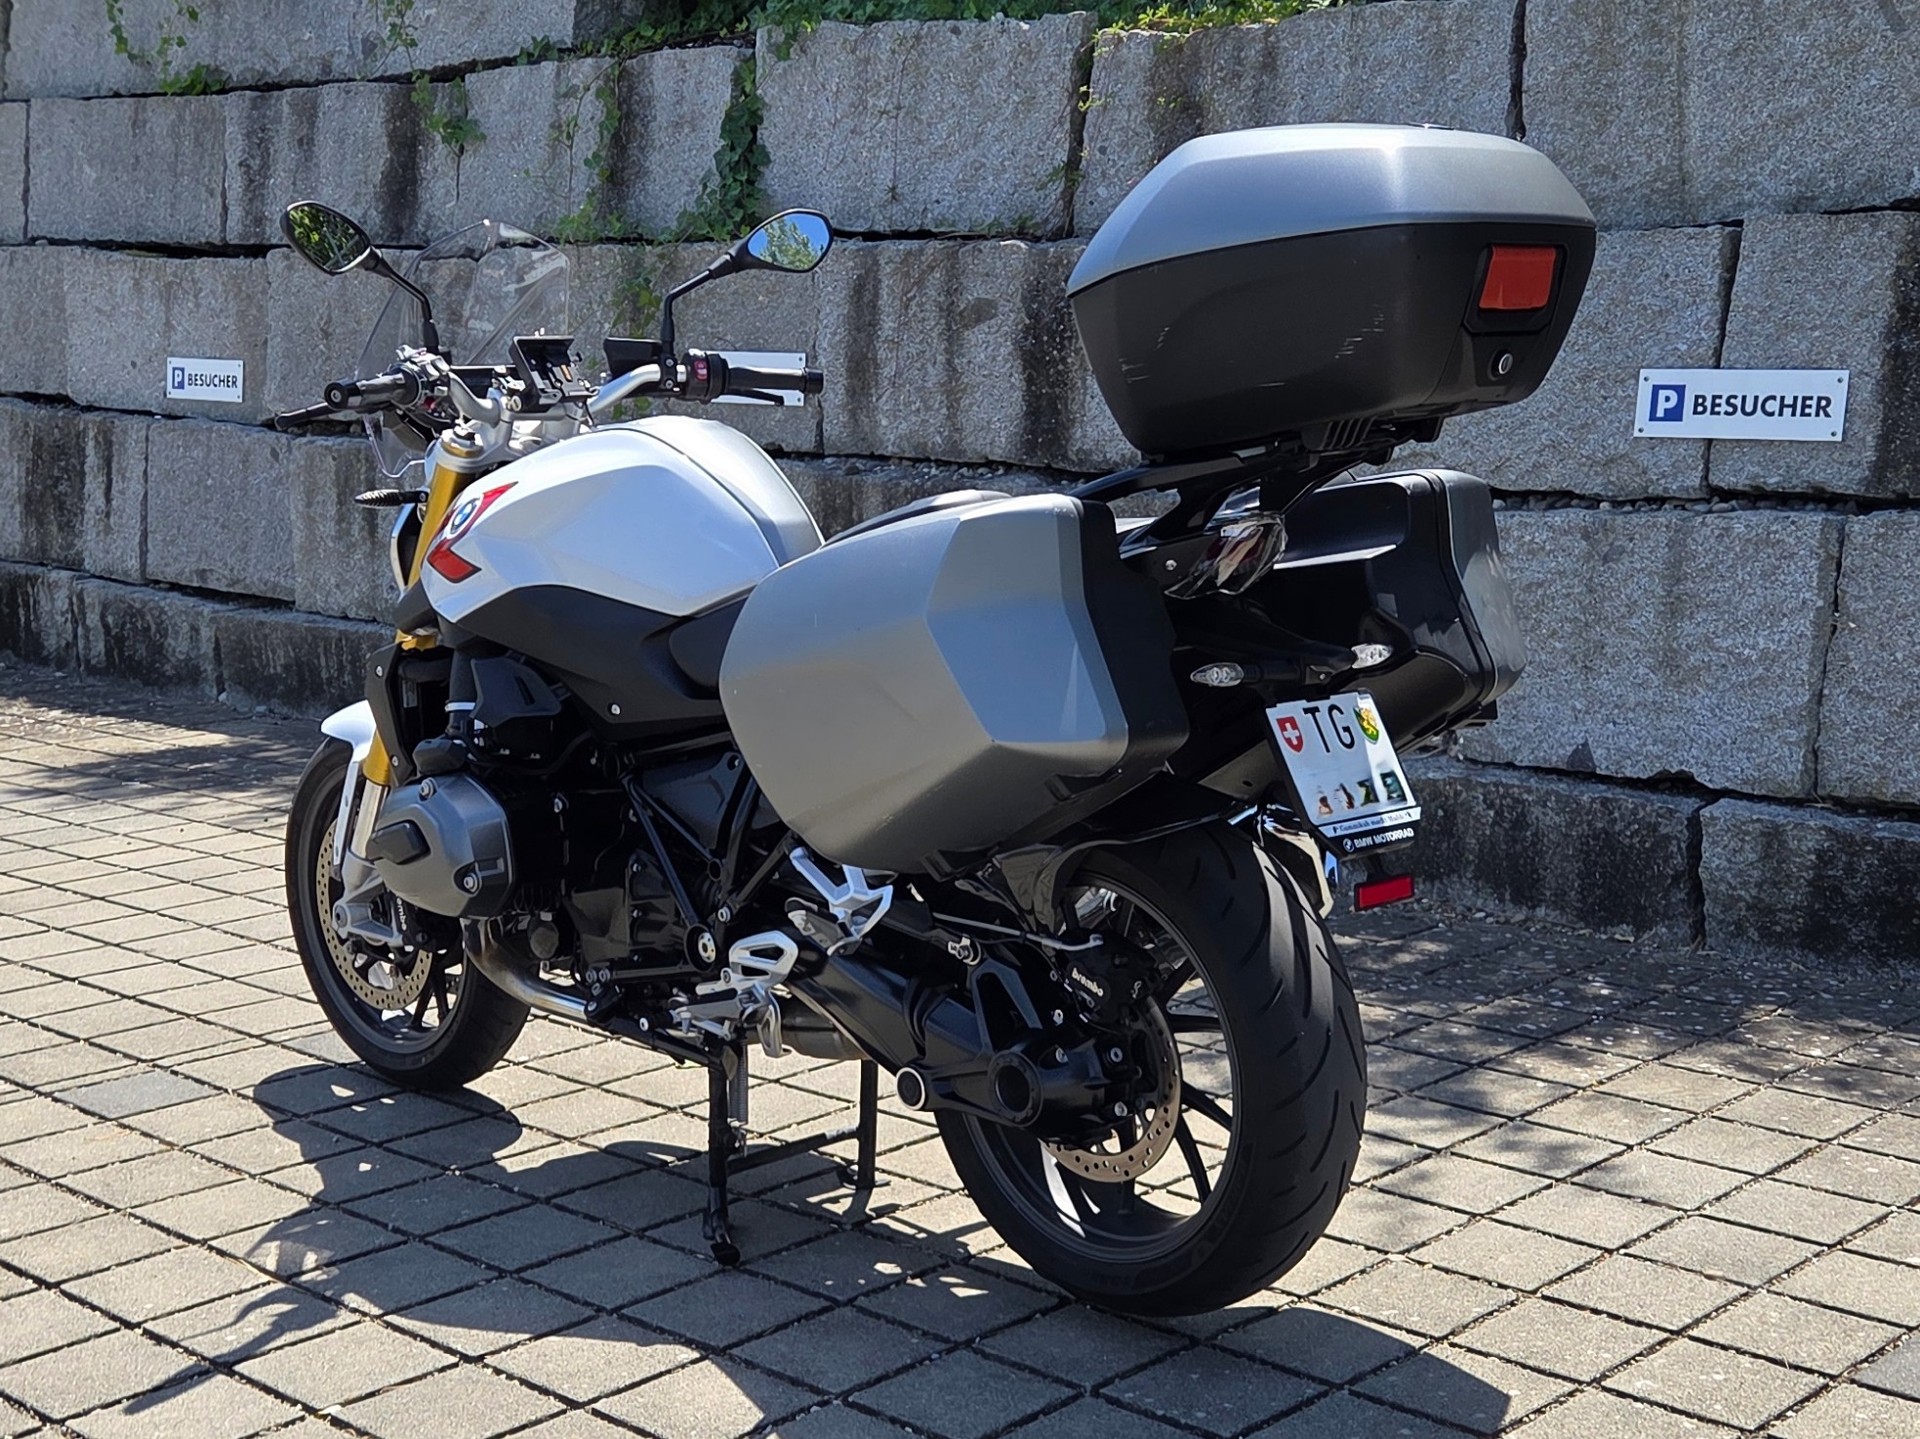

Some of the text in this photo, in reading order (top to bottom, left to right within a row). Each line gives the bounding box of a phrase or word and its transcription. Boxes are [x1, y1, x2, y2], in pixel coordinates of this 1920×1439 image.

[174, 369, 238, 388] P BESUCHER
[1656, 389, 1832, 418] P BESUCHER
[1303, 704, 1355, 753] TG
[1354, 828, 1414, 848] BMW MOTORRAD
[1071, 967, 1104, 997] brembo
